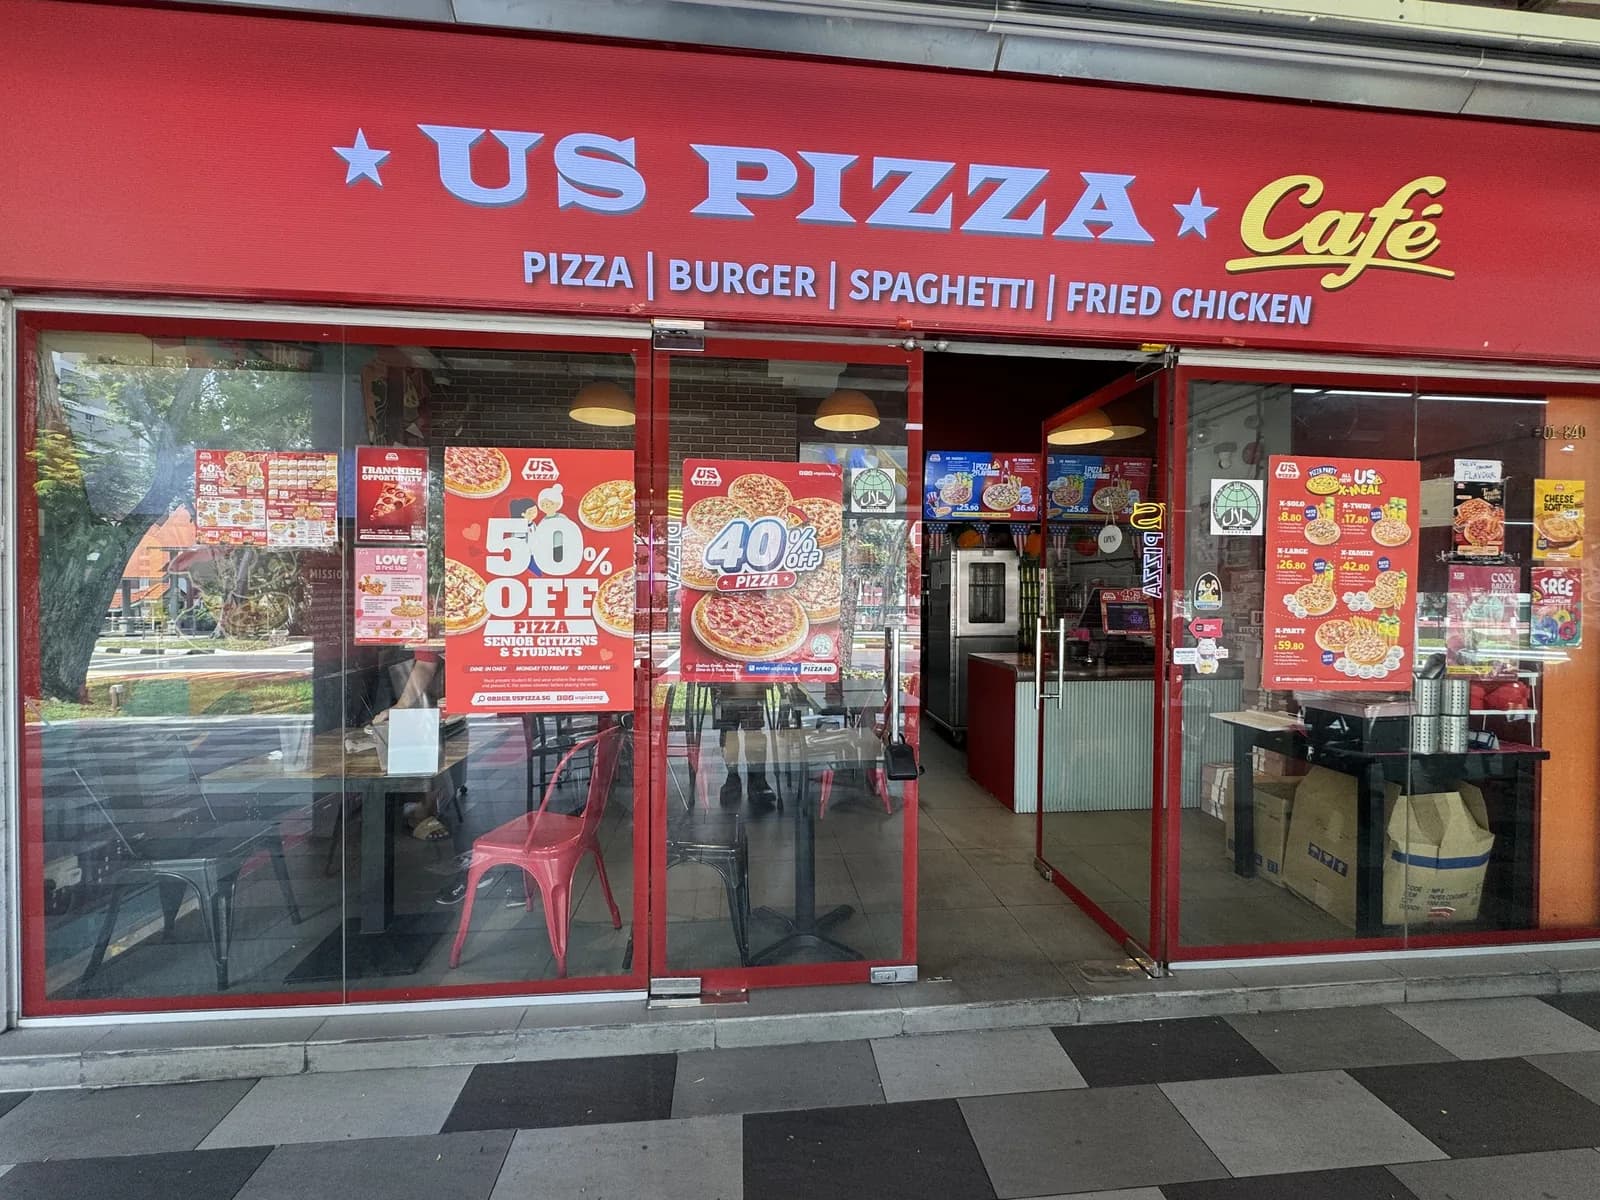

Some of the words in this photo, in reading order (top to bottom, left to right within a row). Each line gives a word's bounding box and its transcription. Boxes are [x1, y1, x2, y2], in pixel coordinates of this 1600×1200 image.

[417, 123, 647, 214] US
[690, 143, 1155, 244] PIZZA
[1239, 174, 1448, 290] Café
[523, 250, 634, 290] PIZZA
[669, 258, 817, 298] BURGER
[849, 269, 1035, 310] SPAGHETTI
[1066, 281, 1162, 318] FRIED
[1171, 287, 1313, 326] CHICKEN
[362, 466, 422, 476] FRANCHISE
[528, 460, 554, 472] US
[1280, 463, 1297, 473] US
[362, 474, 422, 482] OPPORTUNITY
[697, 469, 717, 479] US
[1354, 468, 1376, 485] US
[1338, 484, 1381, 496] X-MEAL
[1544, 494, 1574, 504] CHEESE
[1544, 503, 1563, 512] BOAT
[1222, 507, 1253, 527] حلال
[1278, 511, 1302, 522] $8.80
[1341, 514, 1369, 524] $17.80
[706, 518, 815, 572] 40%
[1103, 535, 1116, 544] OPEN
[486, 518, 613, 576] 50%
[1277, 547, 1308, 555] X-LARGE
[1340, 549, 1374, 557] X-FAMILY
[375, 555, 408, 566] LOVE
[786, 551, 820, 568] OFF
[1277, 559, 1306, 570] $26.80
[1340, 561, 1370, 572] $42.80
[735, 574, 778, 588] PIZZA
[1491, 572, 1517, 583] COOL
[1540, 577, 1574, 597] FREE
[484, 577, 599, 618] OFF
[513, 621, 570, 634] PIZZA
[483, 636, 534, 647] SENIOR
[537, 635, 598, 647] CITIZENS
[1274, 640, 1305, 651] $59.80
[499, 647, 510, 657] &
[512, 646, 583, 657] STUDENTS
